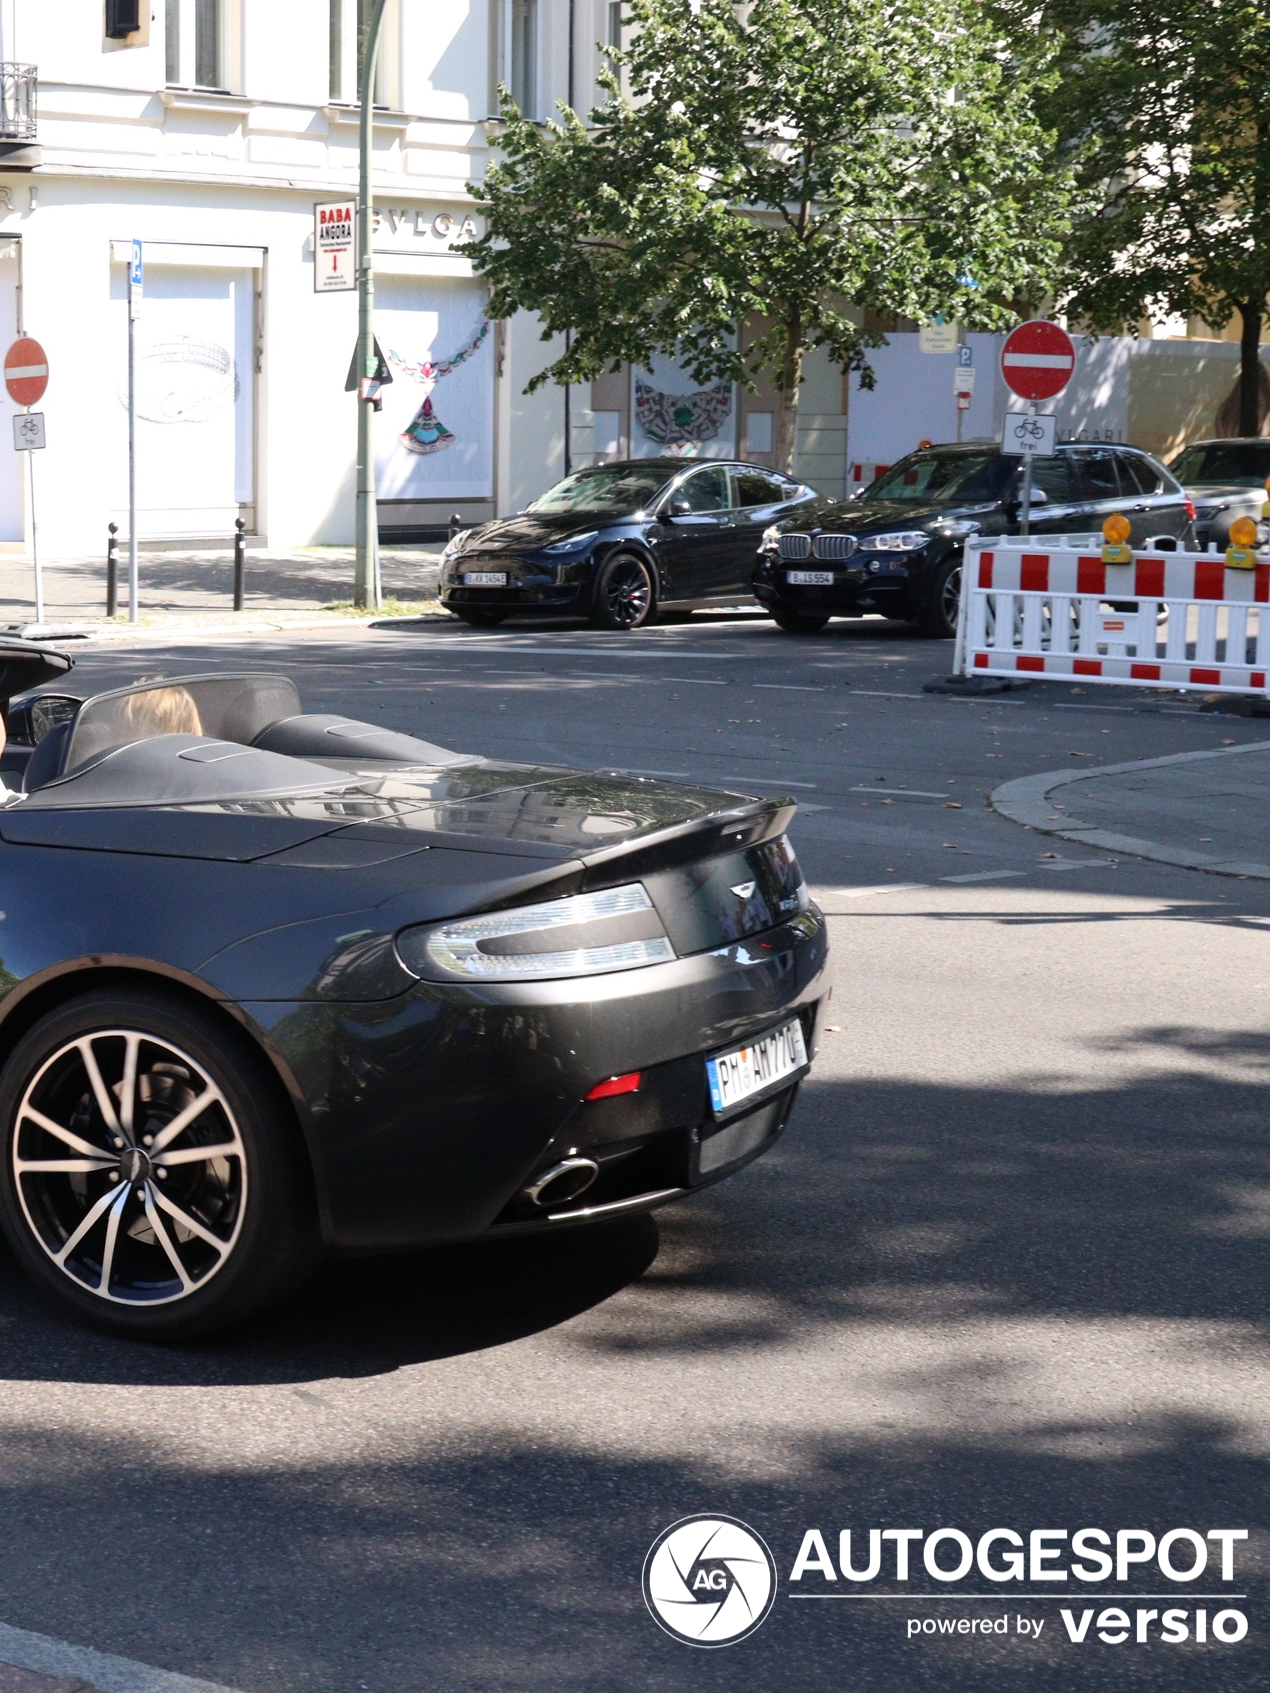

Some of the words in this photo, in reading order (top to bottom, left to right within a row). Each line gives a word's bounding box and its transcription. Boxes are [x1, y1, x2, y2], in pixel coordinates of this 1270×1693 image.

[319, 207, 352, 224] BABA
[319, 224, 352, 241] ANGORA
[1020, 441, 1038, 451] frei
[719, 1055, 742, 1100] PM
